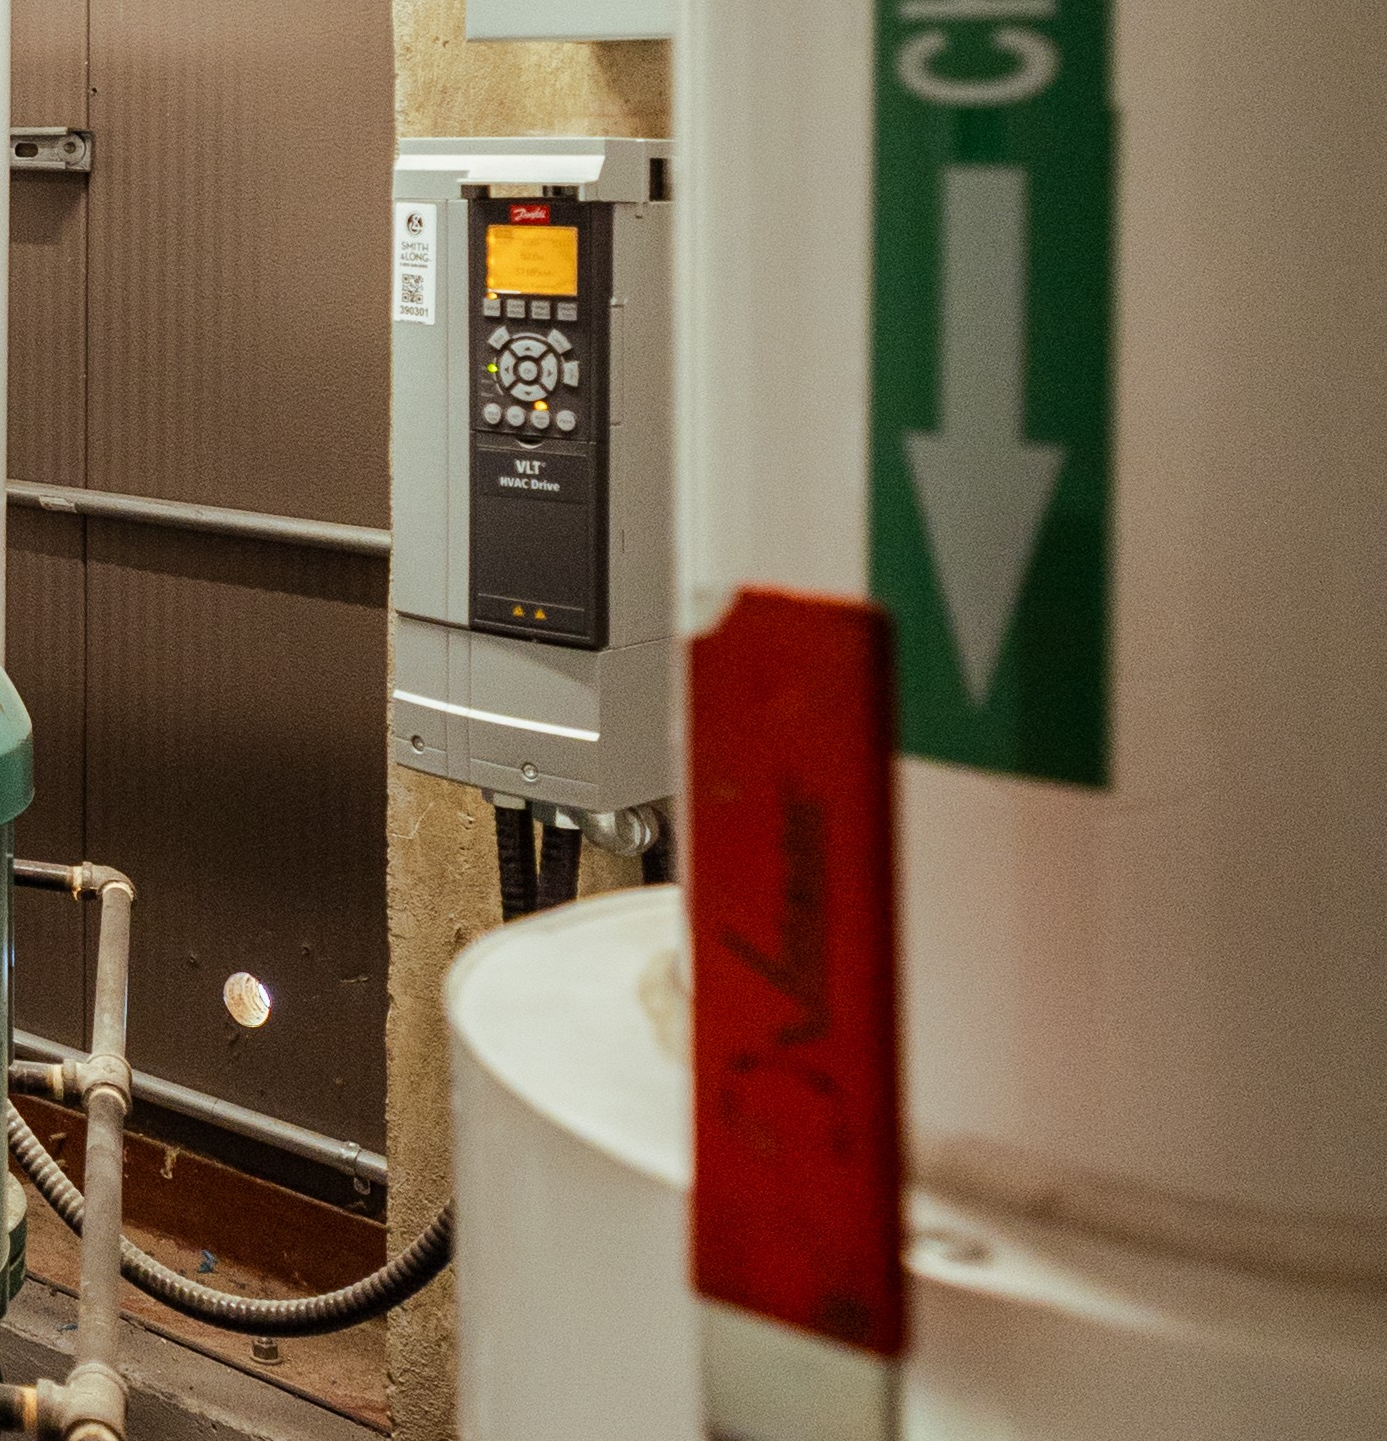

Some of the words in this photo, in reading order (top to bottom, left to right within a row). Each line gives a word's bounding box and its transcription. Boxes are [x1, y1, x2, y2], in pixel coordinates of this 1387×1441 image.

[401, 241, 429, 252] SMITH
[400, 305, 429, 317] 390301
[500, 476, 530, 489] HVAC
[531, 478, 561, 492] Drive
